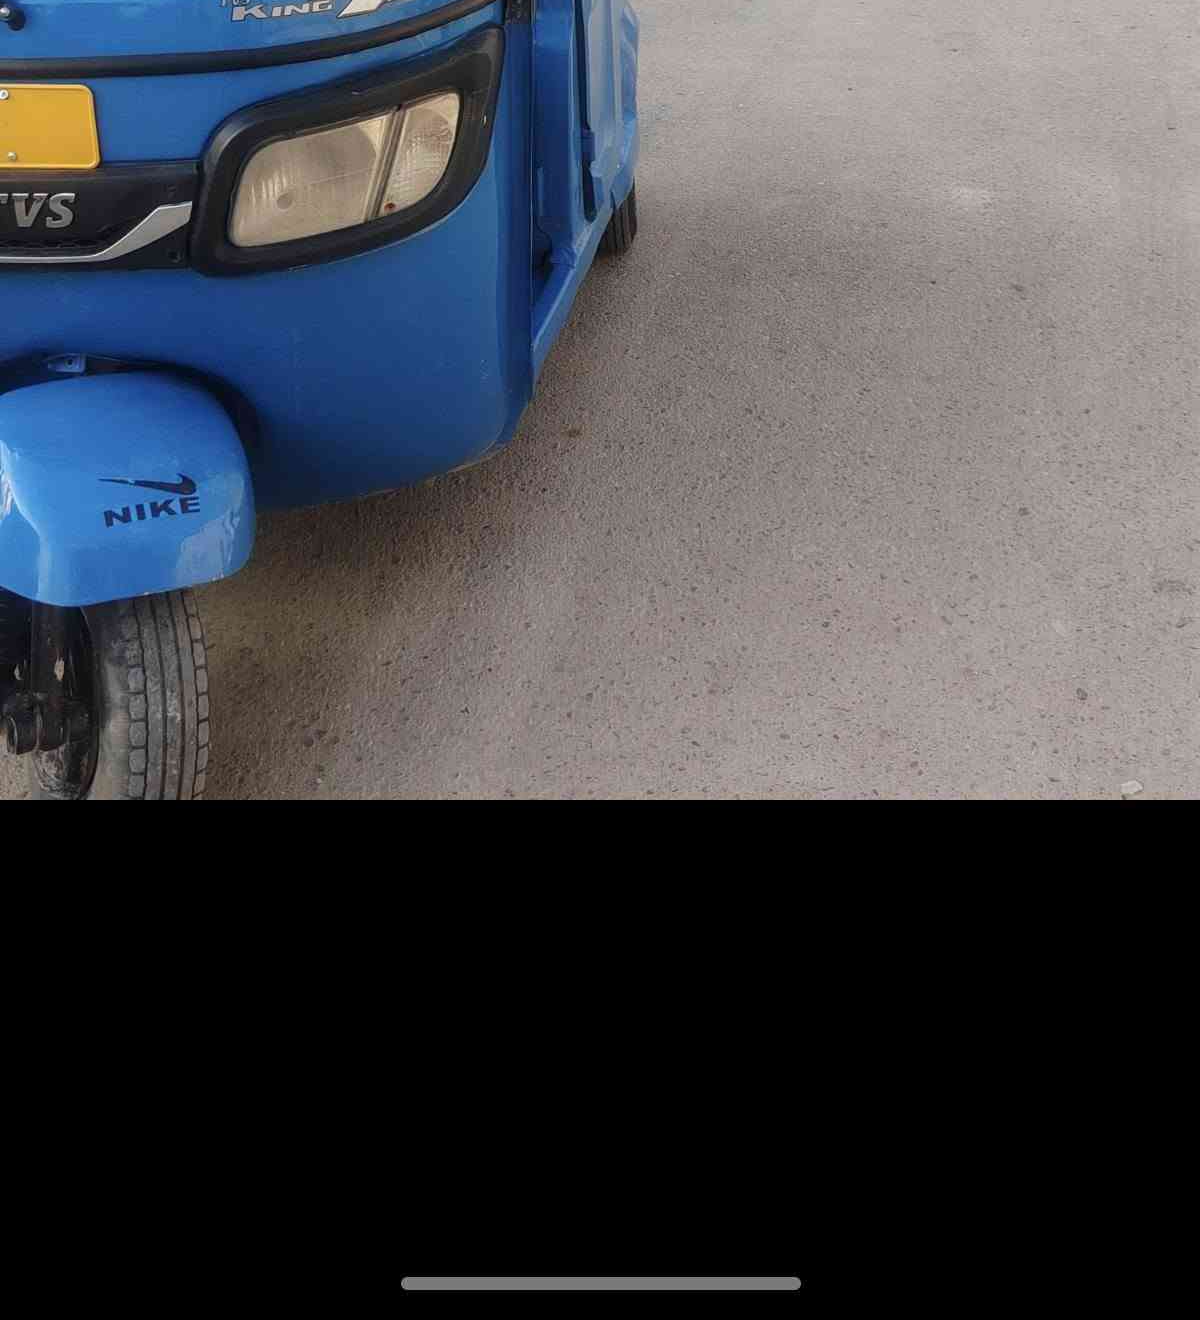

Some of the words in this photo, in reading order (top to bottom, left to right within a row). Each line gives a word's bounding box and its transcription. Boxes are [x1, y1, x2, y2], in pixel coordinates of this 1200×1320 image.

[232, 0, 334, 21] KING
[0, 193, 75, 228] VS
[104, 496, 201, 528] NIKE
